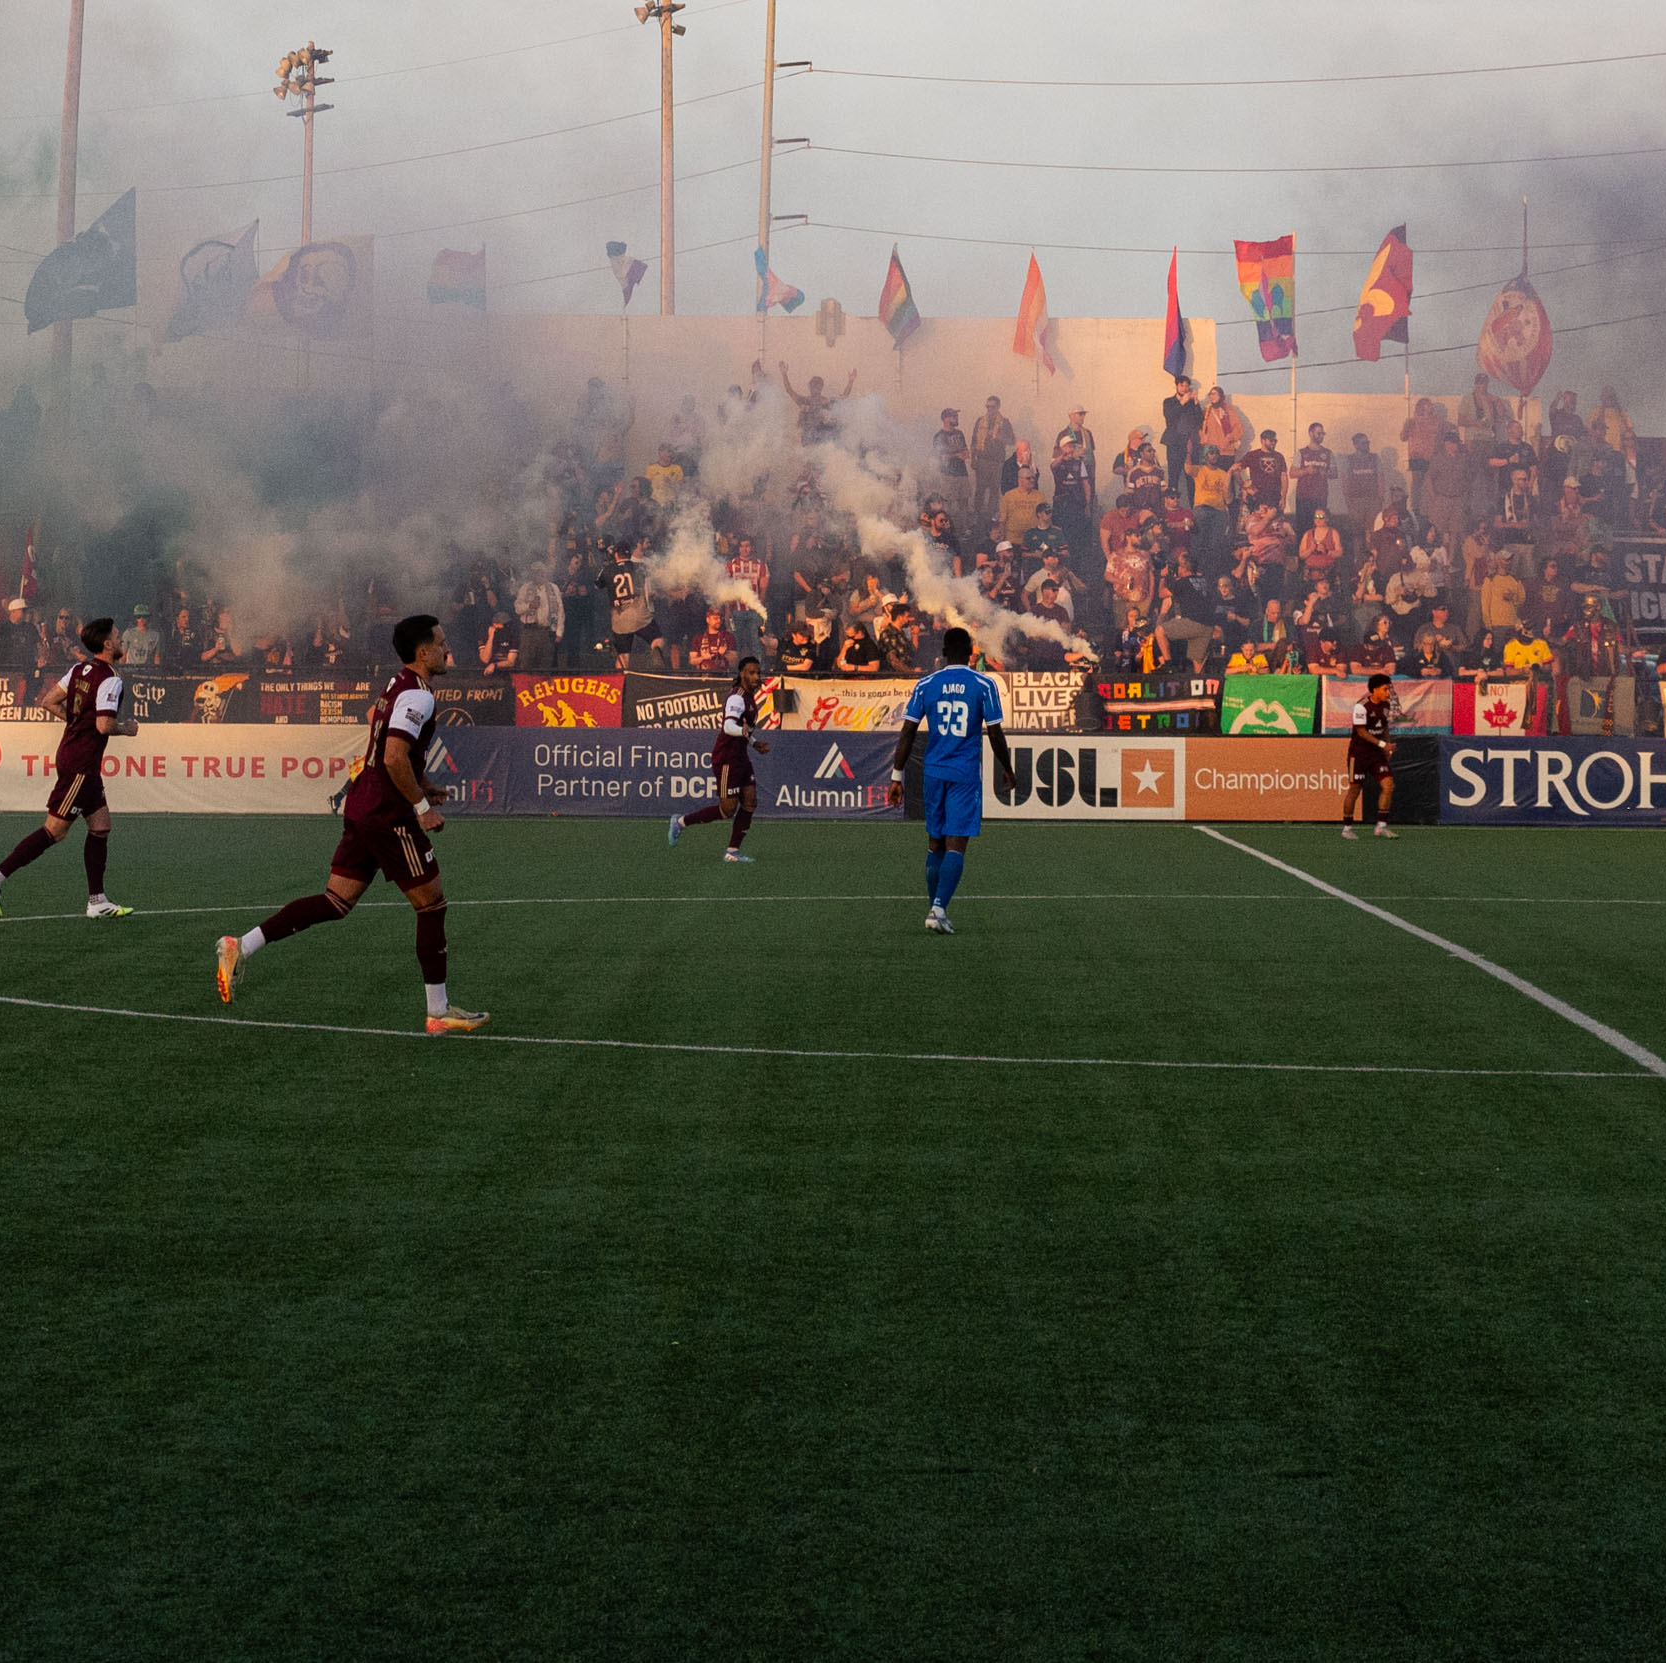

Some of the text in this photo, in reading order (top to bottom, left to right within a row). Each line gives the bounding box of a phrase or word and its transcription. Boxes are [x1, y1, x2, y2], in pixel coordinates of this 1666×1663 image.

[613, 572, 634, 599] 21
[261, 682, 274, 692] THE
[275, 682, 295, 692] ONLY
[296, 682, 323, 692] THINGS
[324, 682, 335, 691] WE
[355, 682, 371, 691] ARE
[942, 683, 966, 695] AJAGO
[1012, 672, 1084, 687] BLACK
[1097, 678, 1220, 699] COALITON
[133, 682, 166, 704] City
[433, 688, 505, 702] ITED FRONT
[517, 677, 621, 707] REFUGEES
[859, 689, 866, 698] is
[867, 690, 892, 699] gonna
[893, 688, 903, 696] be
[904, 689, 913, 697] th
[1014, 690, 1078, 707] LIVES
[1490, 685, 1509, 697] NOT
[260, 694, 306, 715] HATE
[320, 700, 343, 708] RACISM
[320, 707, 343, 715] SEXISM
[636, 691, 723, 721] NO FOOTBALL
[23, 707, 51, 721] JUST
[275, 715, 289, 724] AND
[937, 700, 969, 737] 33
[1492, 714, 1509, 724] FOR
[534, 744, 713, 769] Official Financ
[21, 755, 346, 778] TH ONE TRUE POP
[538, 773, 632, 797] Partner
[639, 776, 664, 797] of
[670, 776, 718, 798] DCF
[993, 747, 1118, 807] USL
[1194, 768, 1351, 795] Championship
